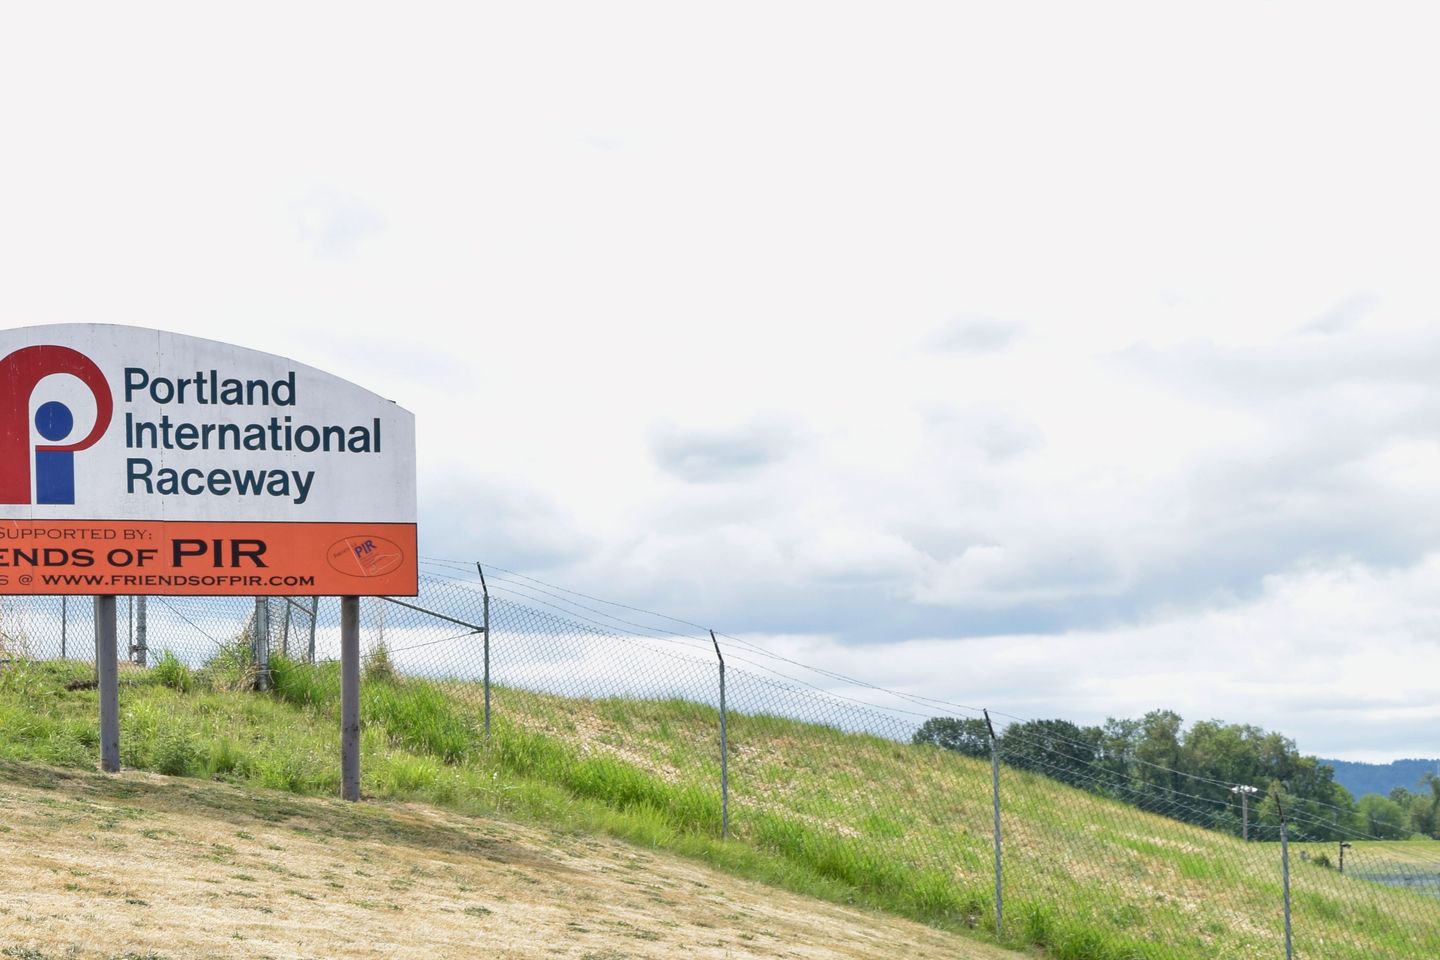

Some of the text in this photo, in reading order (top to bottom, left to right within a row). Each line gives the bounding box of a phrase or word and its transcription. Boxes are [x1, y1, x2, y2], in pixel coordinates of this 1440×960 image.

[123, 366, 296, 406] Portland
[125, 412, 382, 453] International
[126, 457, 316, 505] Raceway
[123, 528, 153, 540] BY:
[355, 540, 377, 558] PIR
[106, 548, 159, 567] OF
[171, 538, 269, 568] PIR
[18, 574, 33, 586] @
[41, 574, 315, 587] WWW.FRIENDSOFPIR.COM
